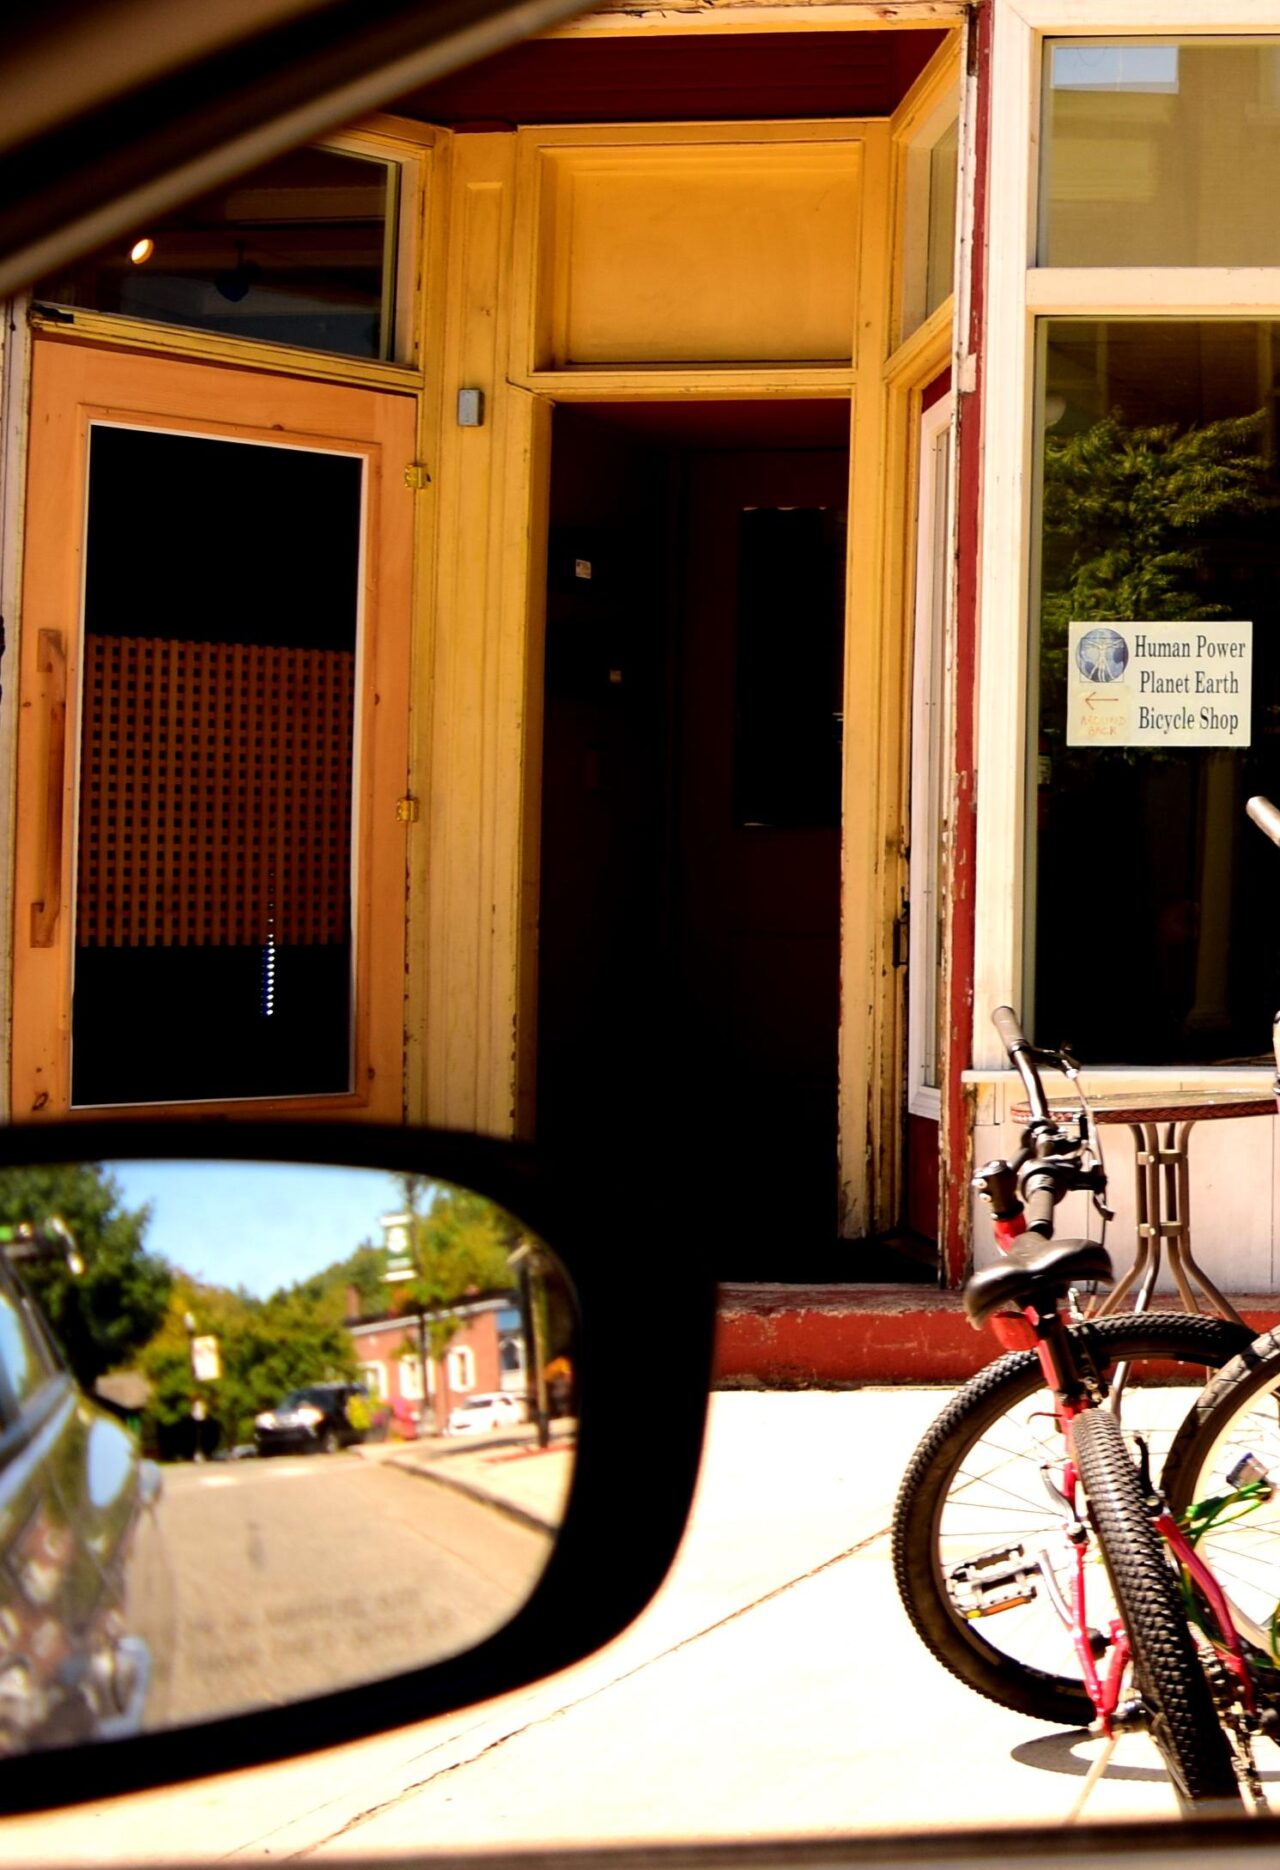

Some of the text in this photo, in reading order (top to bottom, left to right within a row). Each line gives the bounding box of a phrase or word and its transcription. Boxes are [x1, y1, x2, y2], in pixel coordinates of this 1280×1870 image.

[1135, 635, 1246, 658] Human Power
[1139, 671, 1239, 693] Planet Earth
[1138, 706, 1239, 735] Bicycle Shop
